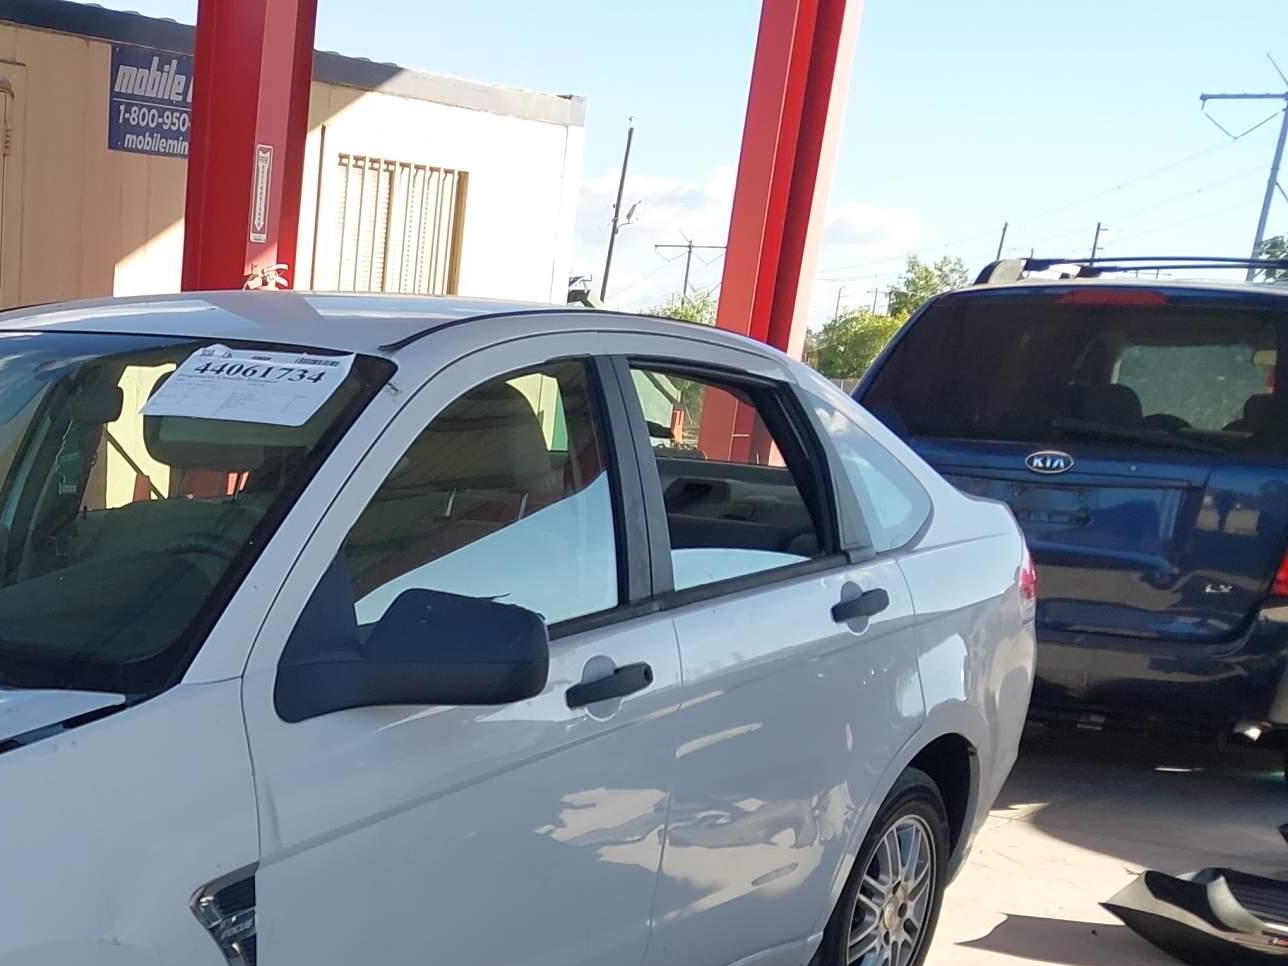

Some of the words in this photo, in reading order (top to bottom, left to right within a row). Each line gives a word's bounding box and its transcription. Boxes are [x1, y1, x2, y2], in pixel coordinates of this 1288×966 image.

[114, 56, 186, 102] mobile
[194, 363, 326, 383] 44061734
[1033, 456, 1064, 468] KIA
